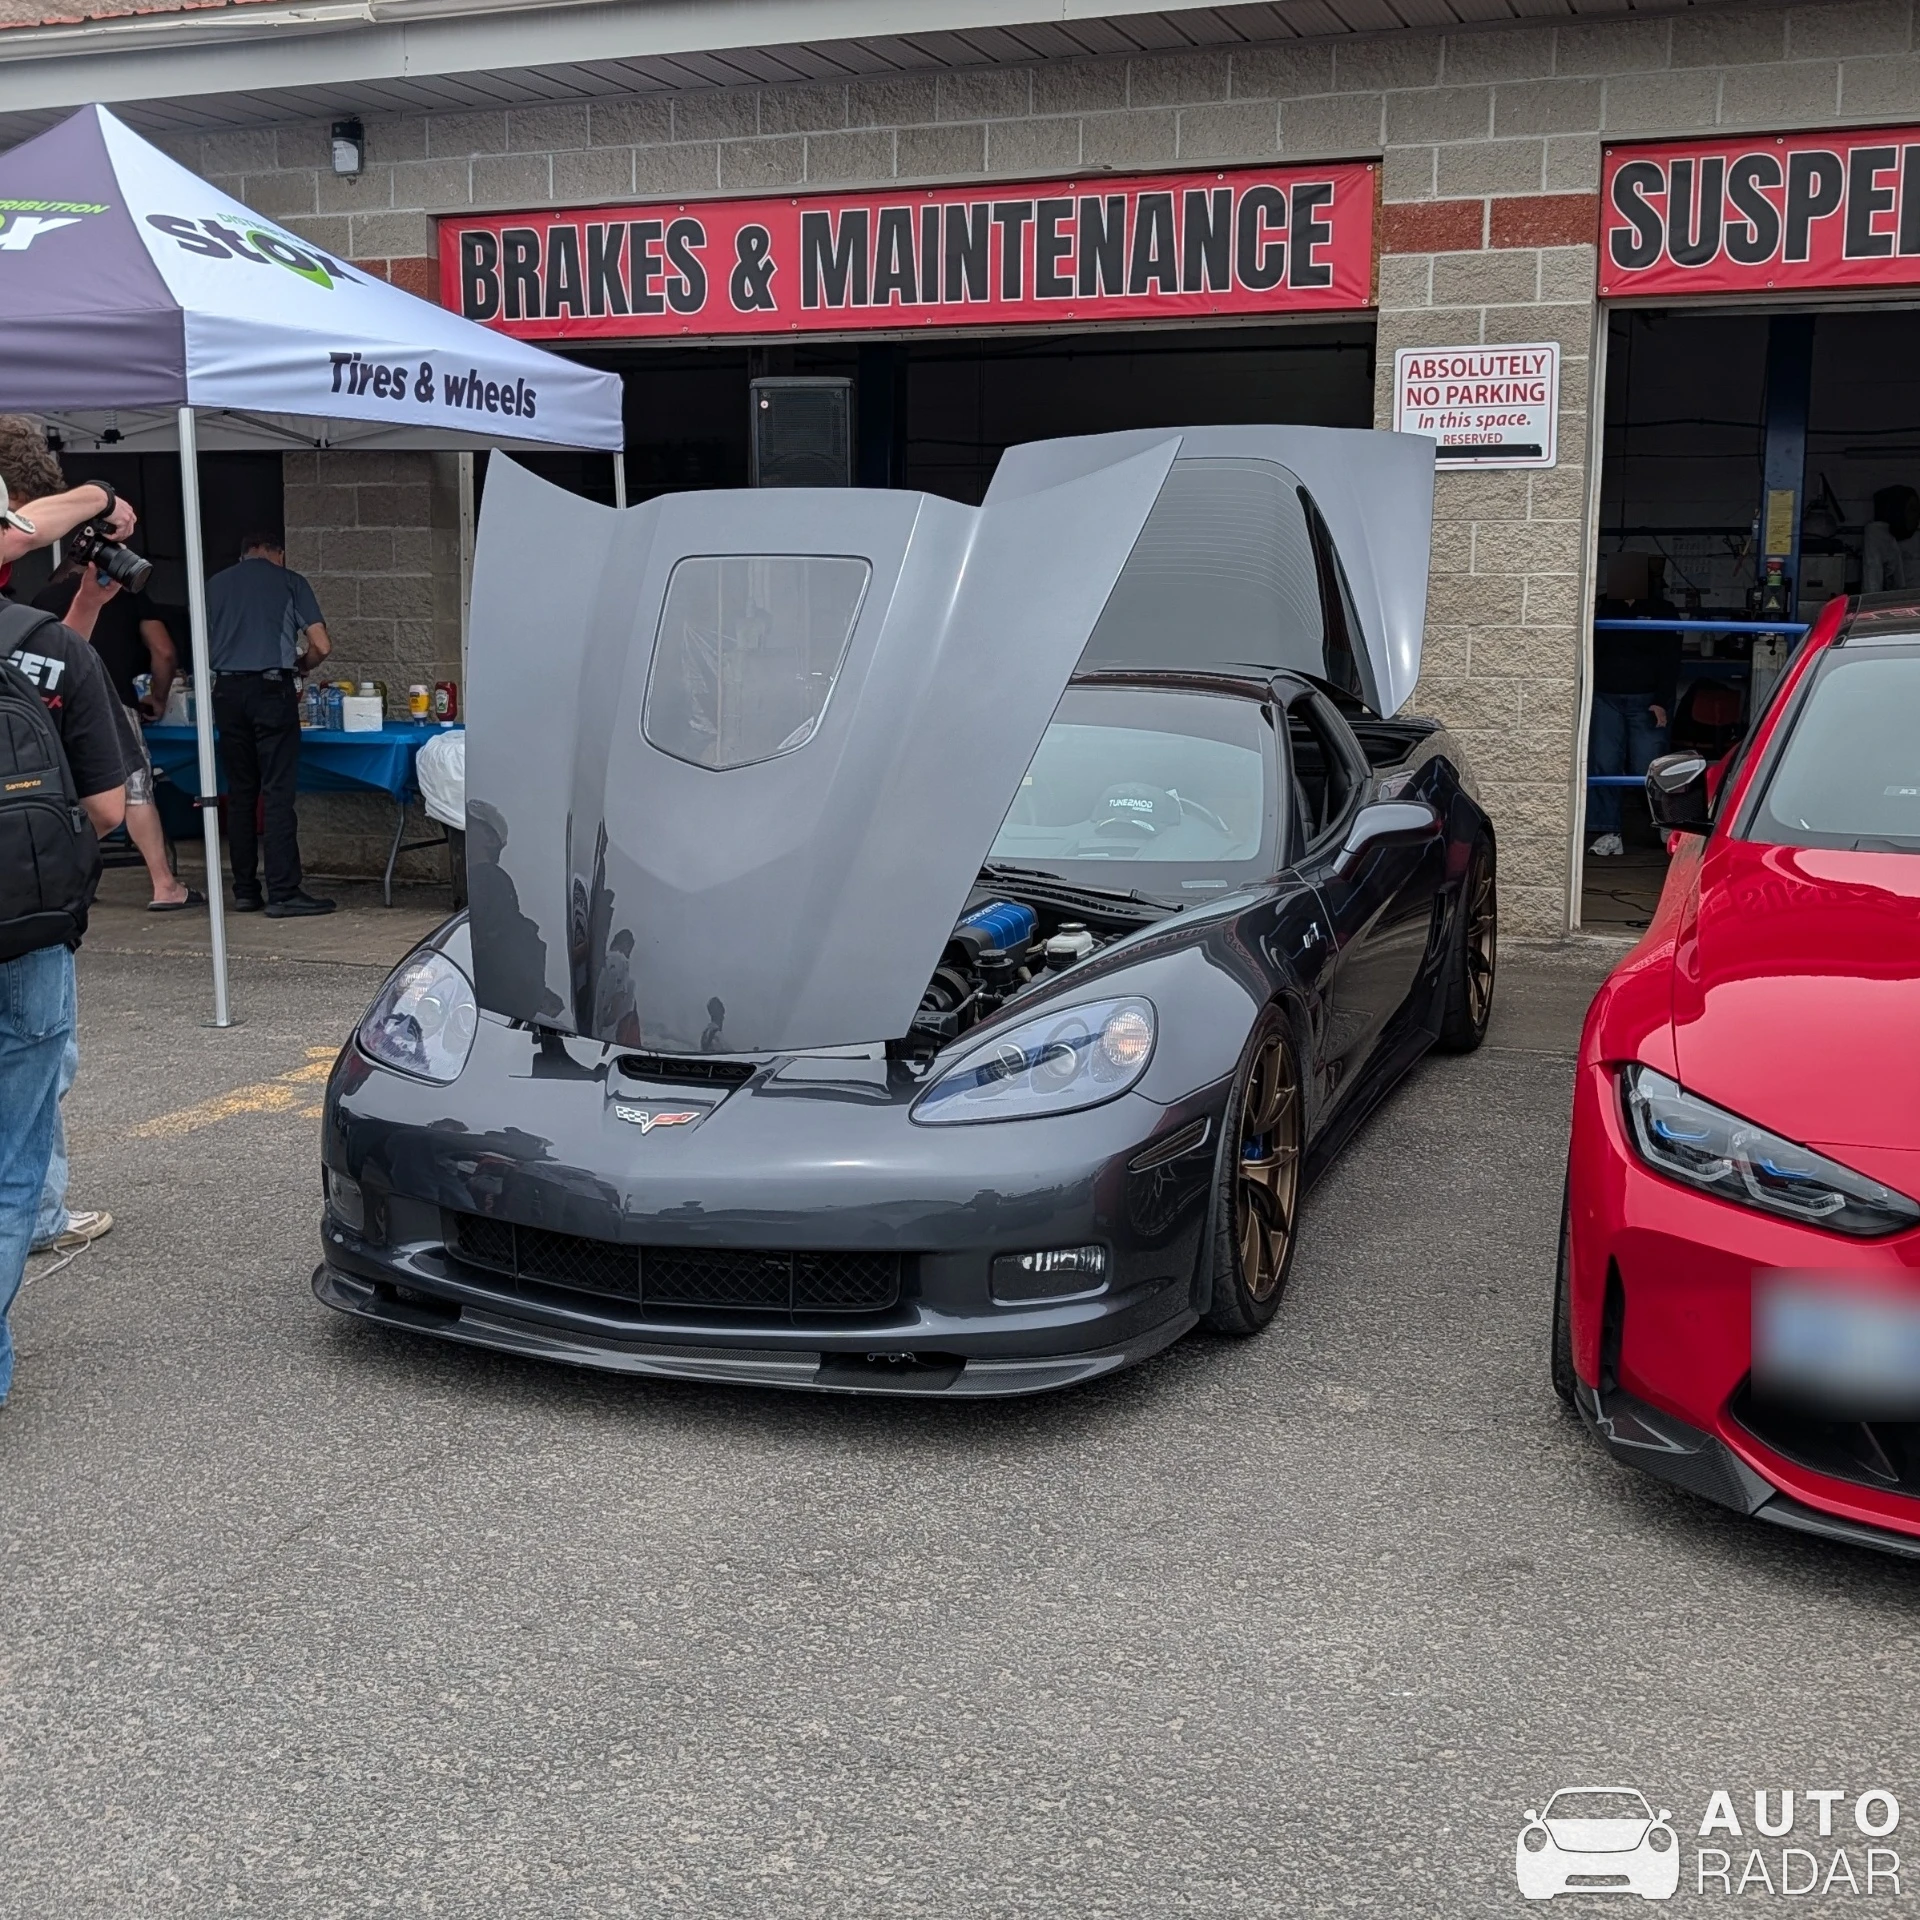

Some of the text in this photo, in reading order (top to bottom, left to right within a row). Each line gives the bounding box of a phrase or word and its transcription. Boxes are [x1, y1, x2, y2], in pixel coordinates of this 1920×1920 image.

[459, 181, 1335, 322] BRAKES & MAINTENANCE
[1407, 354, 1547, 379] ABSOLUTELY
[329, 352, 537, 419] Tires & wheels
[1406, 382, 1546, 406] NO PARKING
[1418, 411, 1532, 431] In this space.
[1443, 433, 1503, 445] RESERVED
